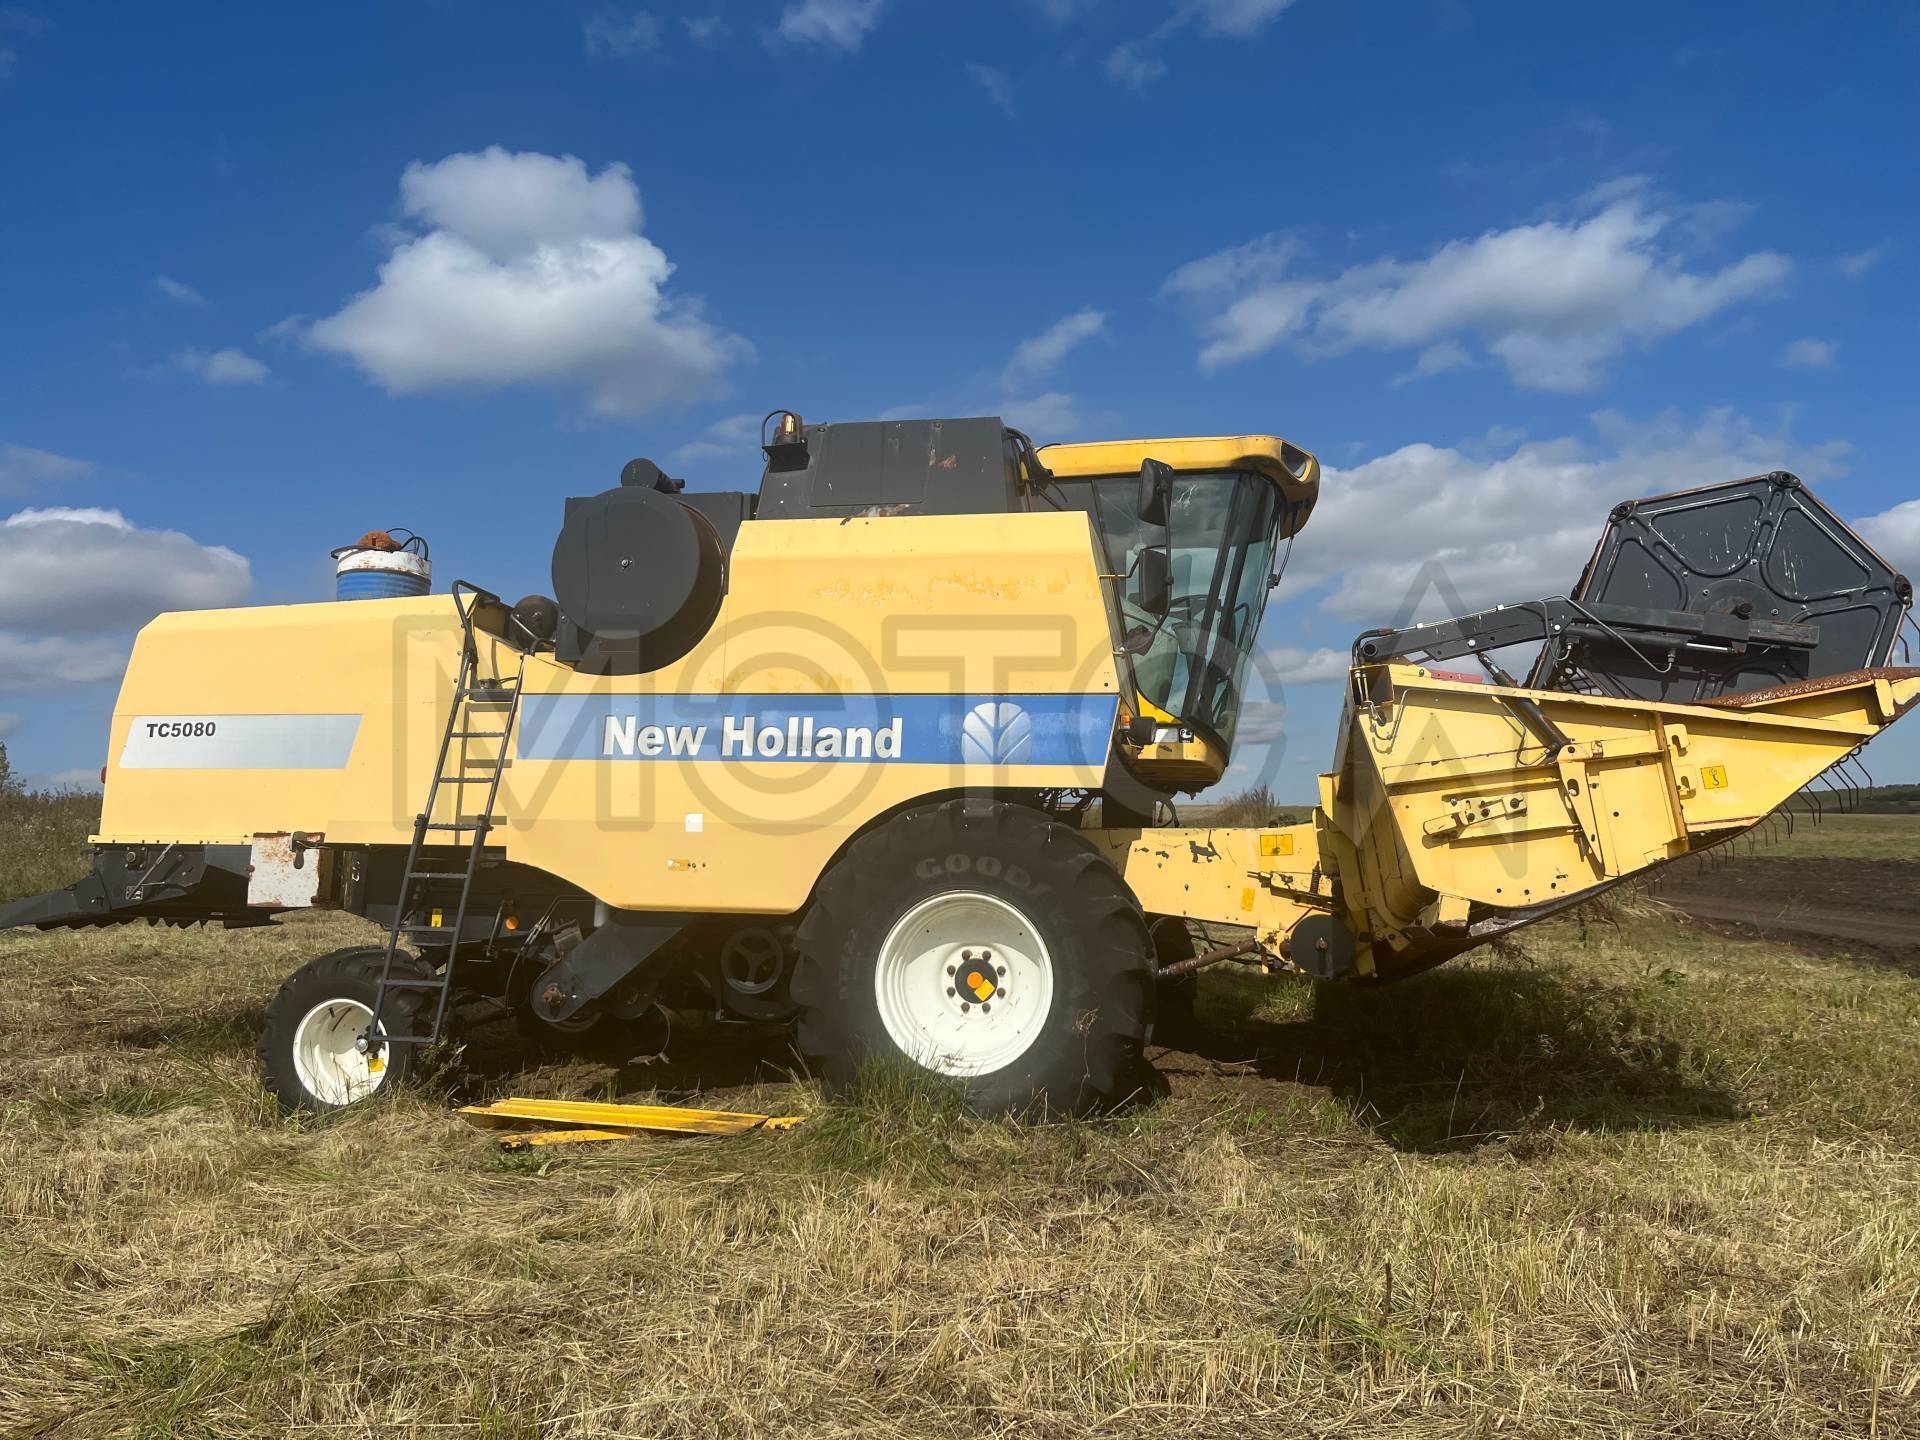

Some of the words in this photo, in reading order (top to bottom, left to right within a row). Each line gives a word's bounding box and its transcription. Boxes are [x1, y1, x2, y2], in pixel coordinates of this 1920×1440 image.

[146, 721, 217, 738] TC5080
[602, 715, 708, 756] New
[721, 715, 904, 758] Holland
